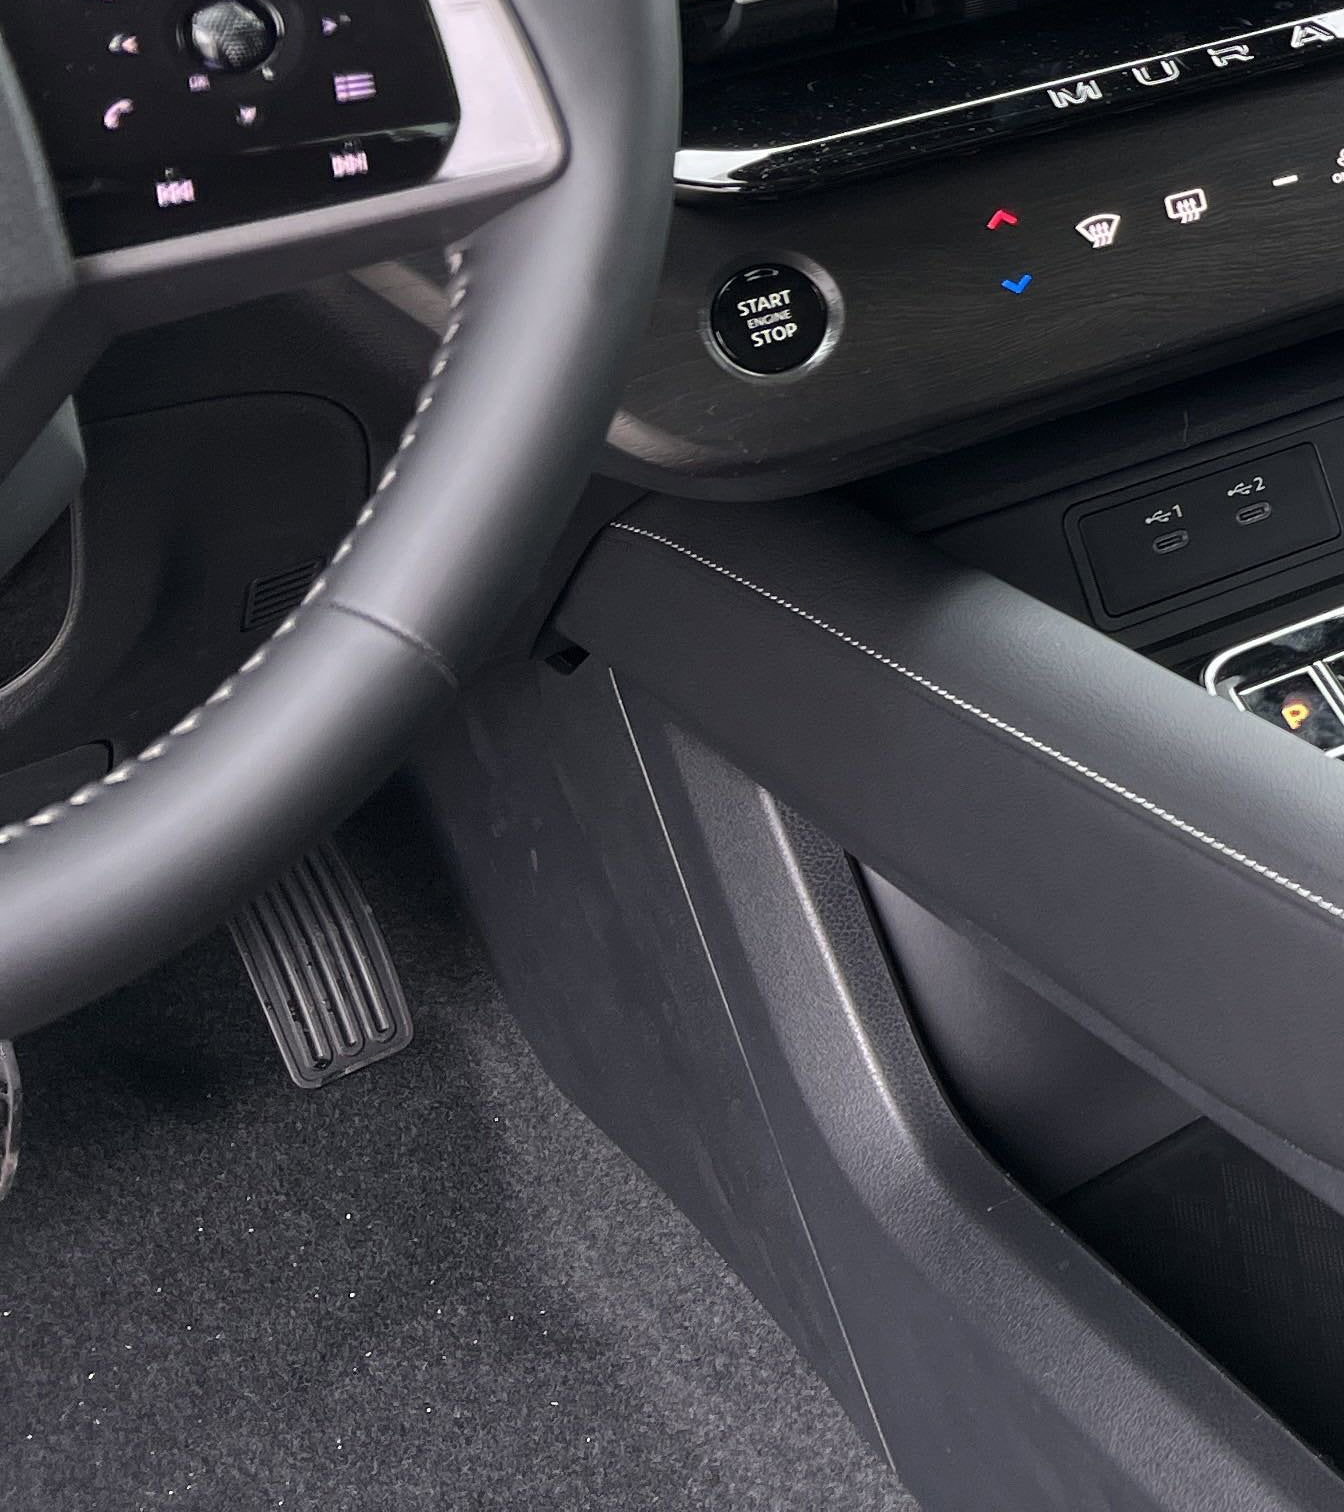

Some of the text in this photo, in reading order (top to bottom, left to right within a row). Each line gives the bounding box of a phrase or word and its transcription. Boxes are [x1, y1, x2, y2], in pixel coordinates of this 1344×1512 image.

[737, 289, 791, 317] START
[746, 308, 793, 330] ENGINE
[751, 322, 798, 348] STOP
[1253, 476, 1266, 492] 2
[1172, 504, 1183, 518] 1
[1281, 702, 1310, 731] P
